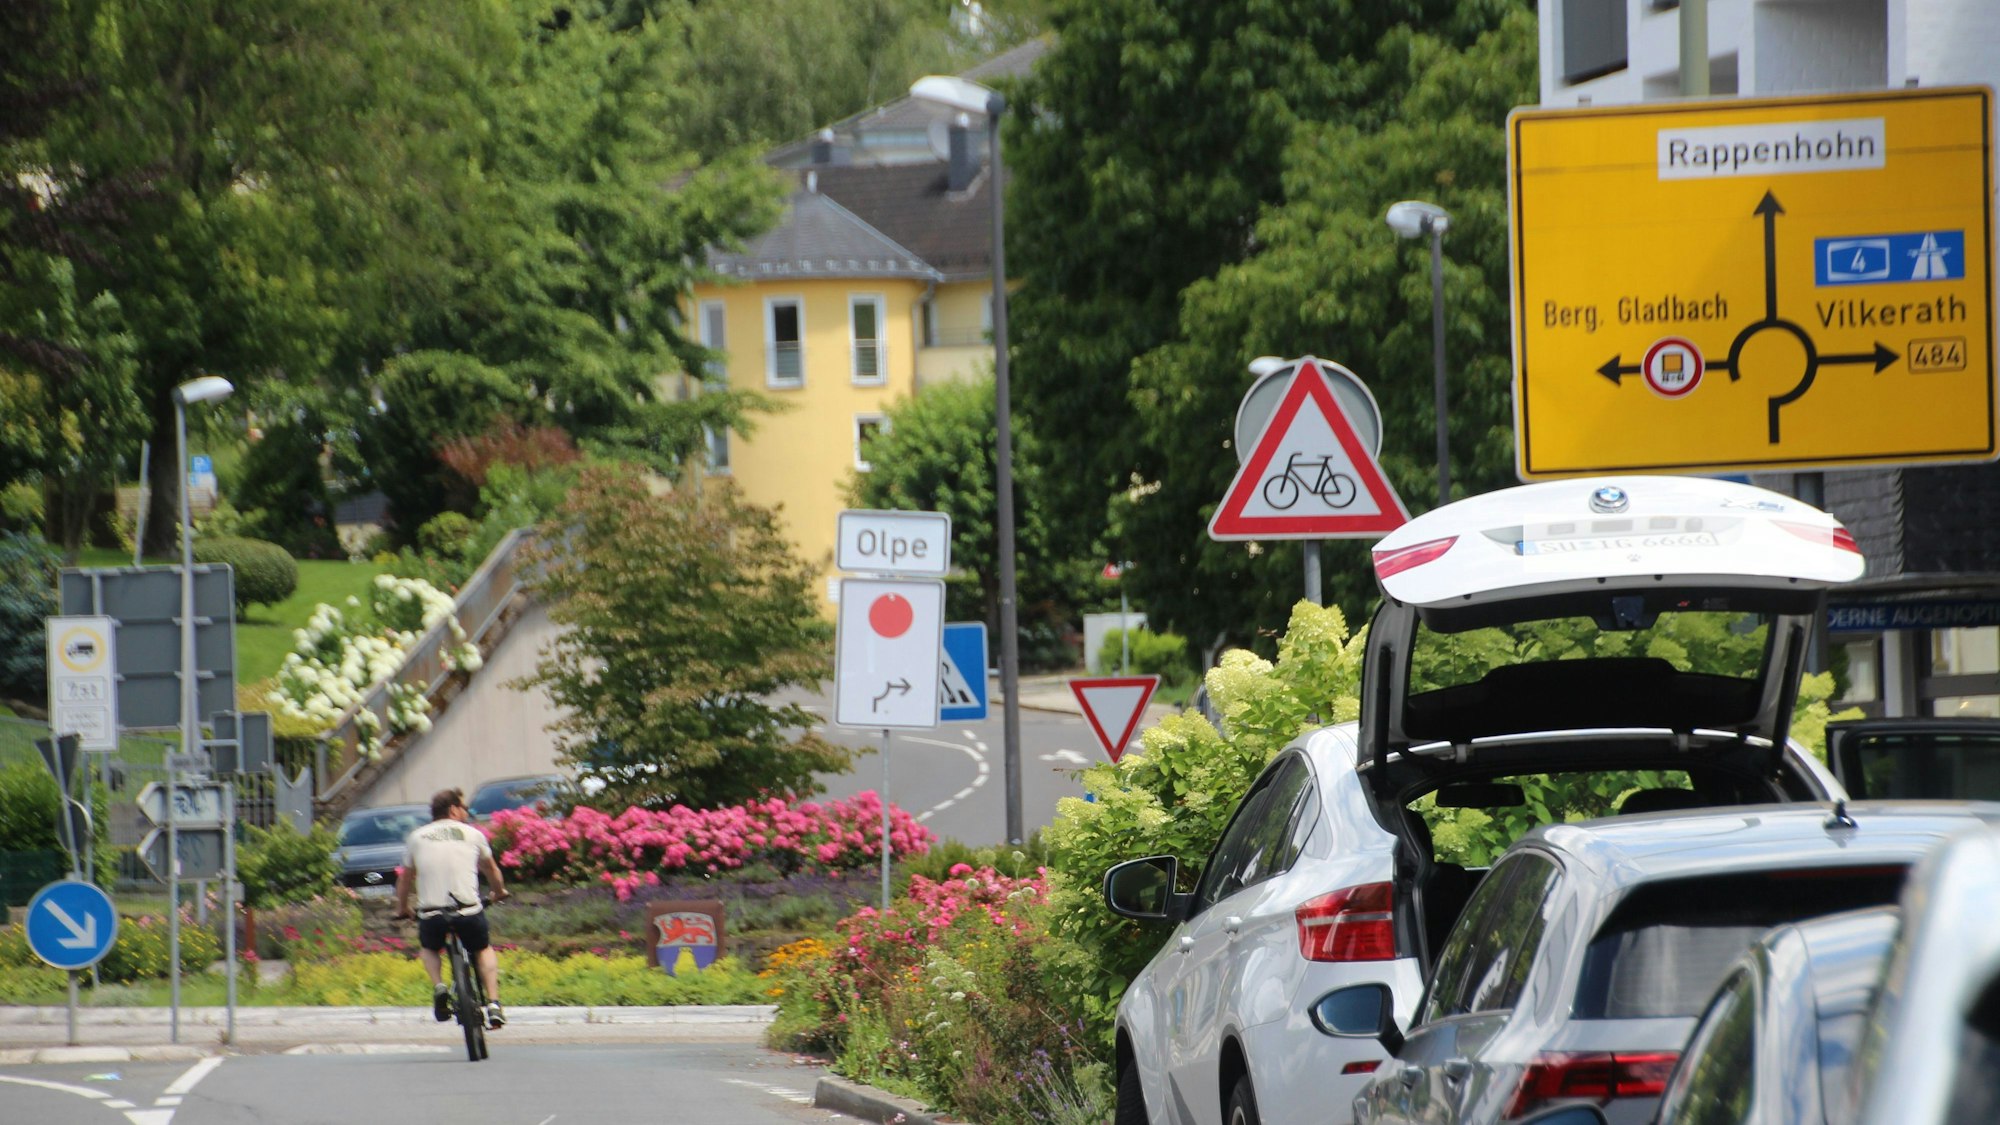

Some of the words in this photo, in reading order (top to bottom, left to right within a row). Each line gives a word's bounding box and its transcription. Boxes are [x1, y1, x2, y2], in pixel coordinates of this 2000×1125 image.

[1669, 129, 1875, 172] Rappenhohn
[1851, 247, 1866, 272] 4
[1544, 300, 1604, 334] Berg.
[1617, 293, 1728, 325] Gladbach
[1816, 294, 1966, 329] Vilkerath
[1915, 343, 1960, 366] 484
[857, 528, 928, 565] Olpe
